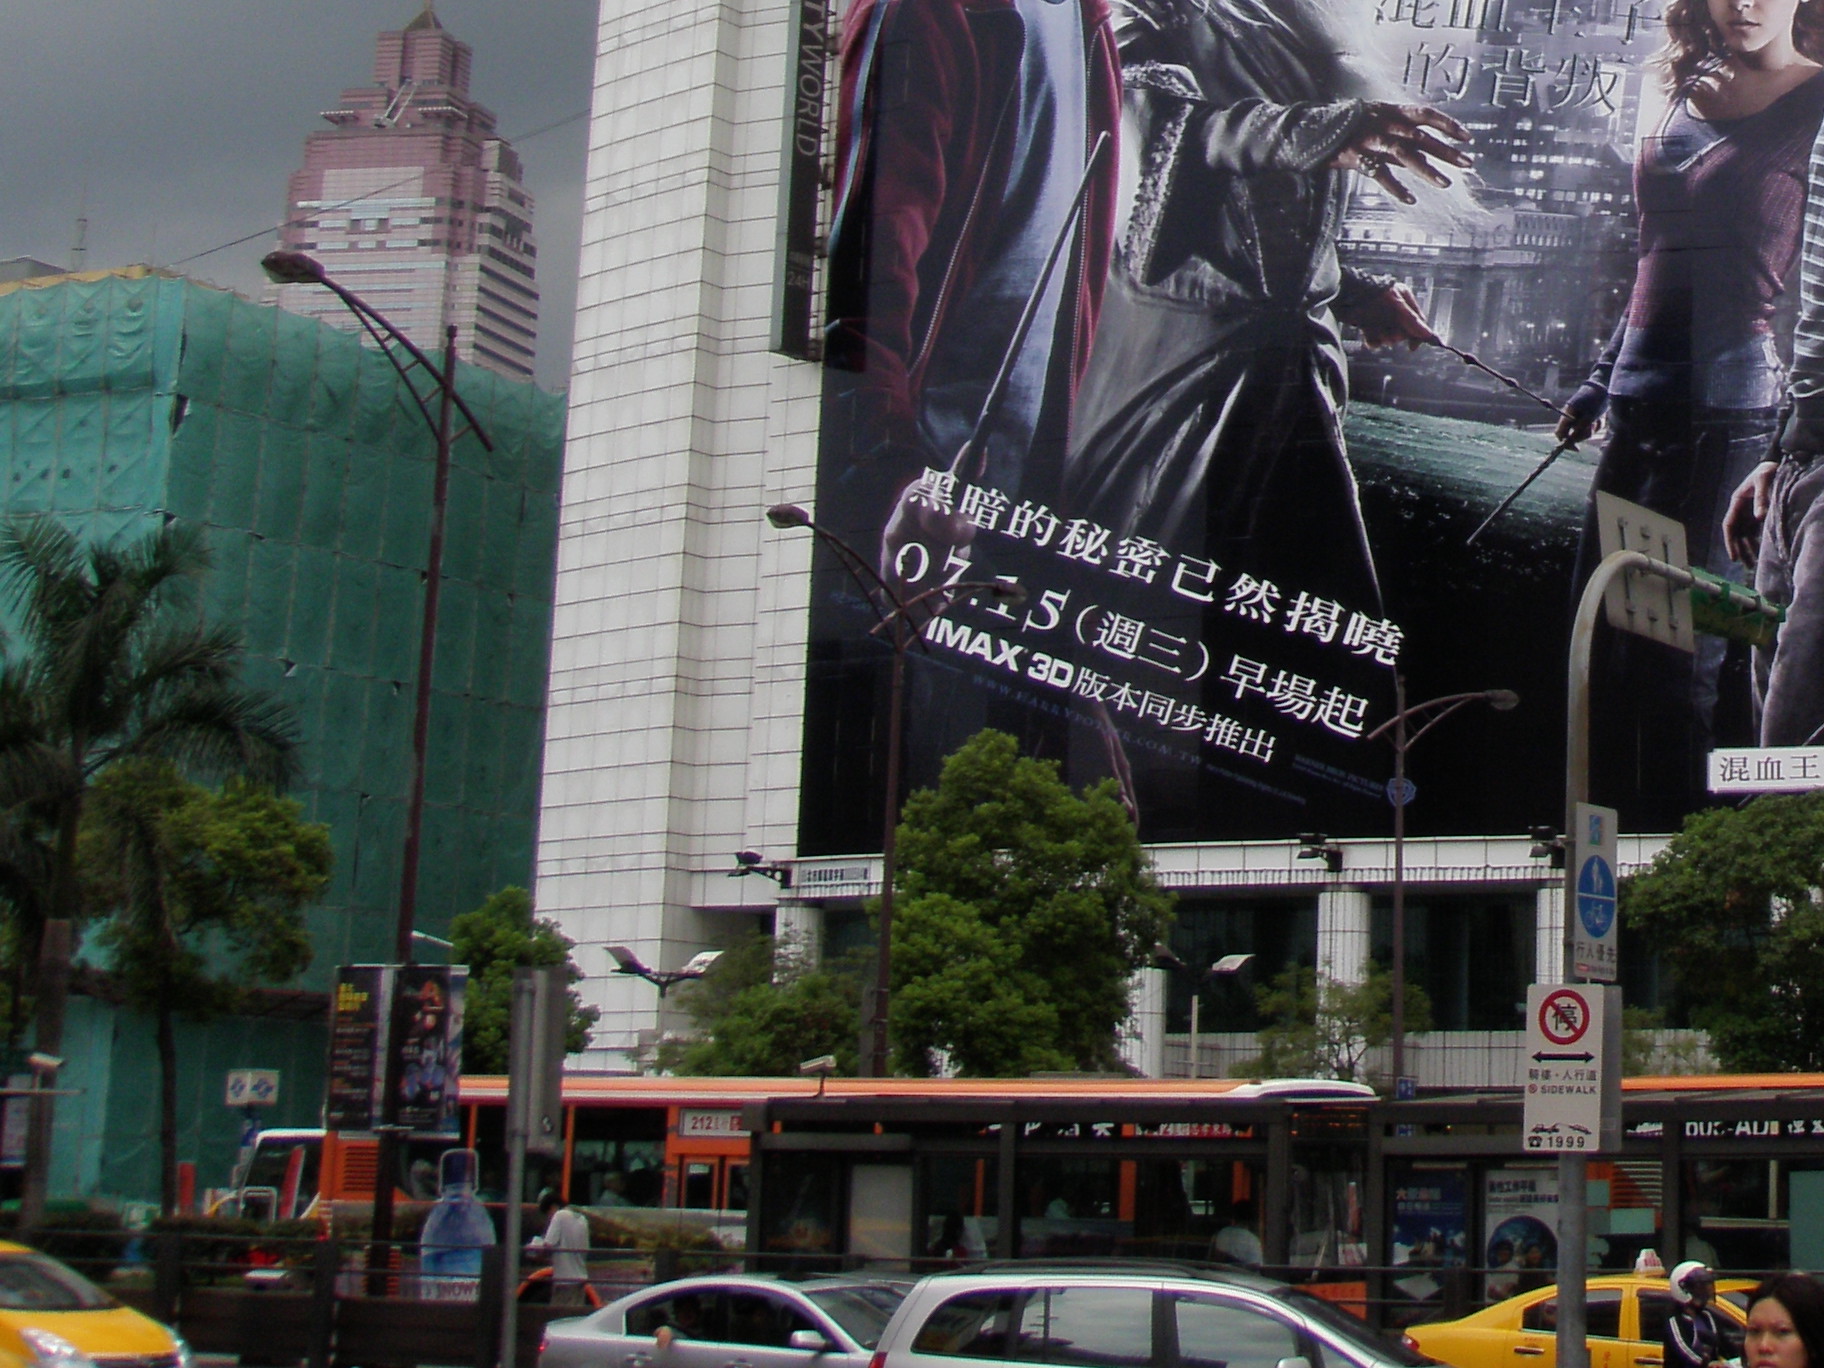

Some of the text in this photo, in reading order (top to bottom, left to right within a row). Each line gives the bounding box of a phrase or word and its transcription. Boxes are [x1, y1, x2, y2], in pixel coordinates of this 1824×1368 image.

[1402, 39, 1634, 118] 的背叛
[924, 616, 1024, 674] IMAX
[1540, 1084, 1597, 1095] SIDEWALK
[1547, 1135, 1585, 1149] 1999
